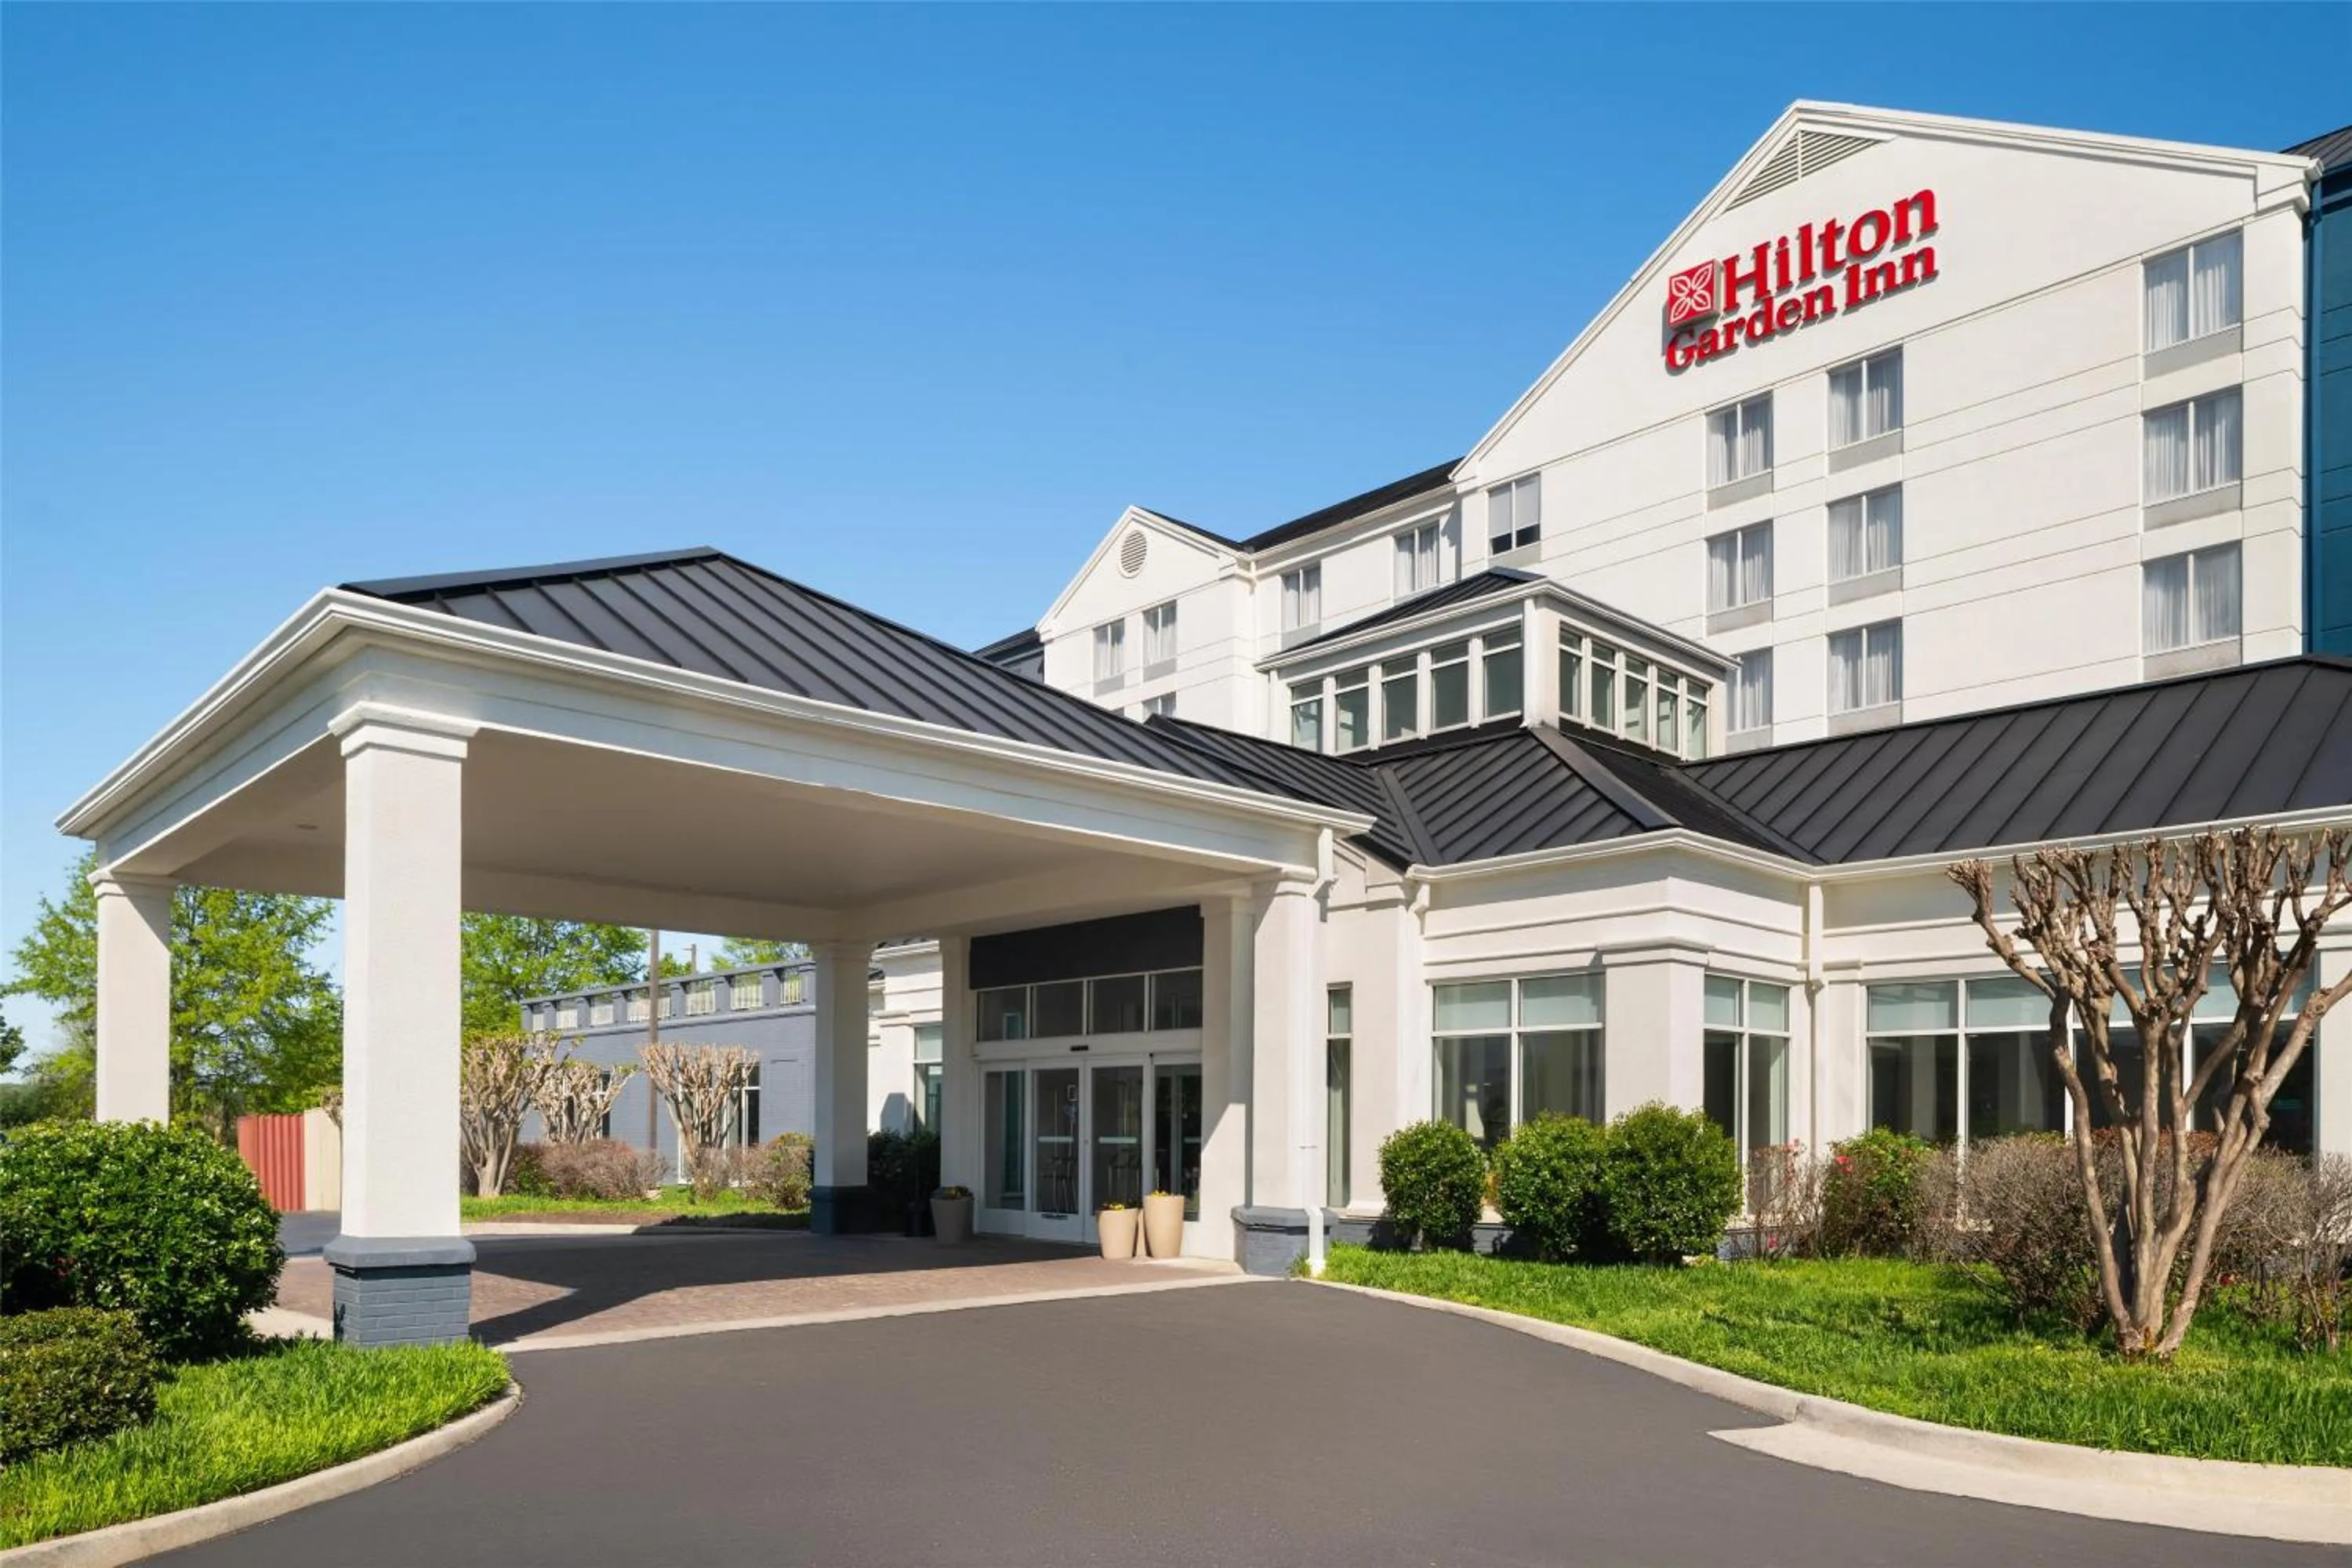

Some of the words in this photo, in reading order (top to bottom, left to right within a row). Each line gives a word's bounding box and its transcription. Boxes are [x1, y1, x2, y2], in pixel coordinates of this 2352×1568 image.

[1665, 284, 1837, 369] Garden
[1845, 245, 1938, 308] Inn
[1722, 188, 1938, 313] Hilton
